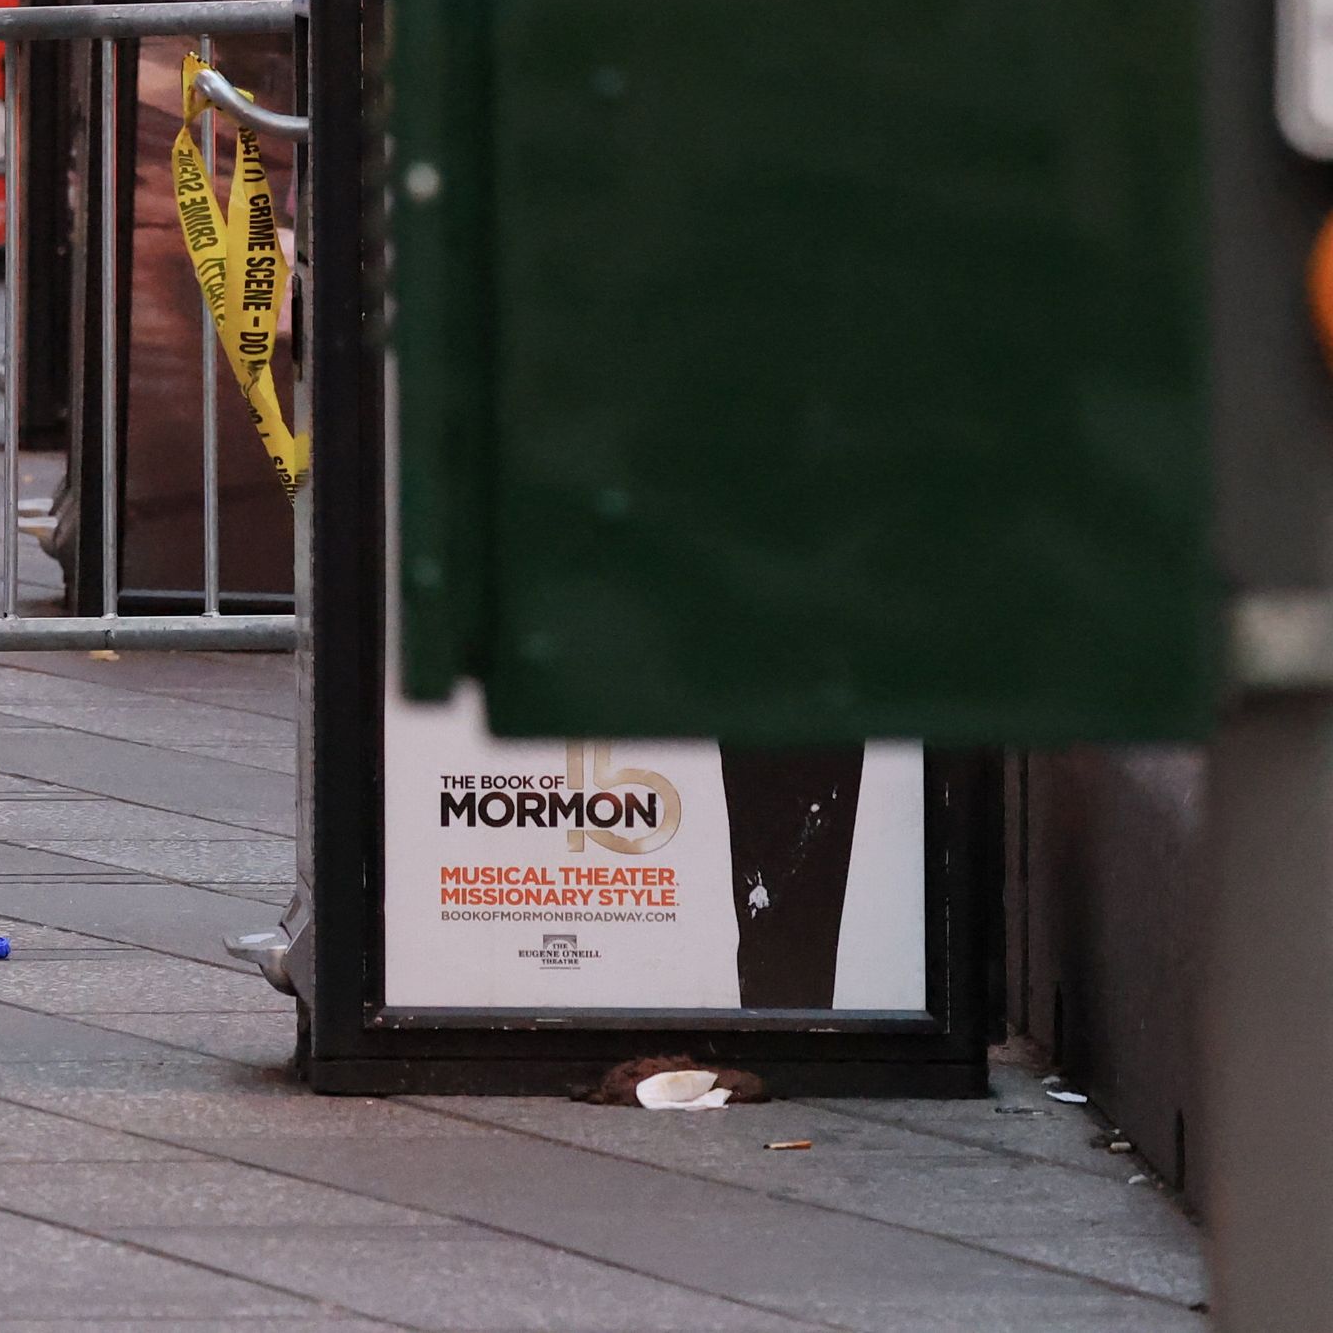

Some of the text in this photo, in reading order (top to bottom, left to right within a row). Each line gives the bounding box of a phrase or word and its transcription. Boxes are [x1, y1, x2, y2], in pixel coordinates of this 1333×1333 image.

[247, 193, 276, 252] CRIME
[243, 257, 276, 311] SCENE
[239, 331, 269, 355] DO
[440, 775, 566, 790] THE BOOK OF
[440, 791, 657, 829] MORMON
[440, 866, 680, 886] MUSICAL THEATER.
[440, 887, 680, 907] MISSIONARY STYLE.
[441, 910, 677, 923] BOOKOFMORMONBROADWAY.COM
[518, 950, 602, 958] EUGENE O'NEILL
